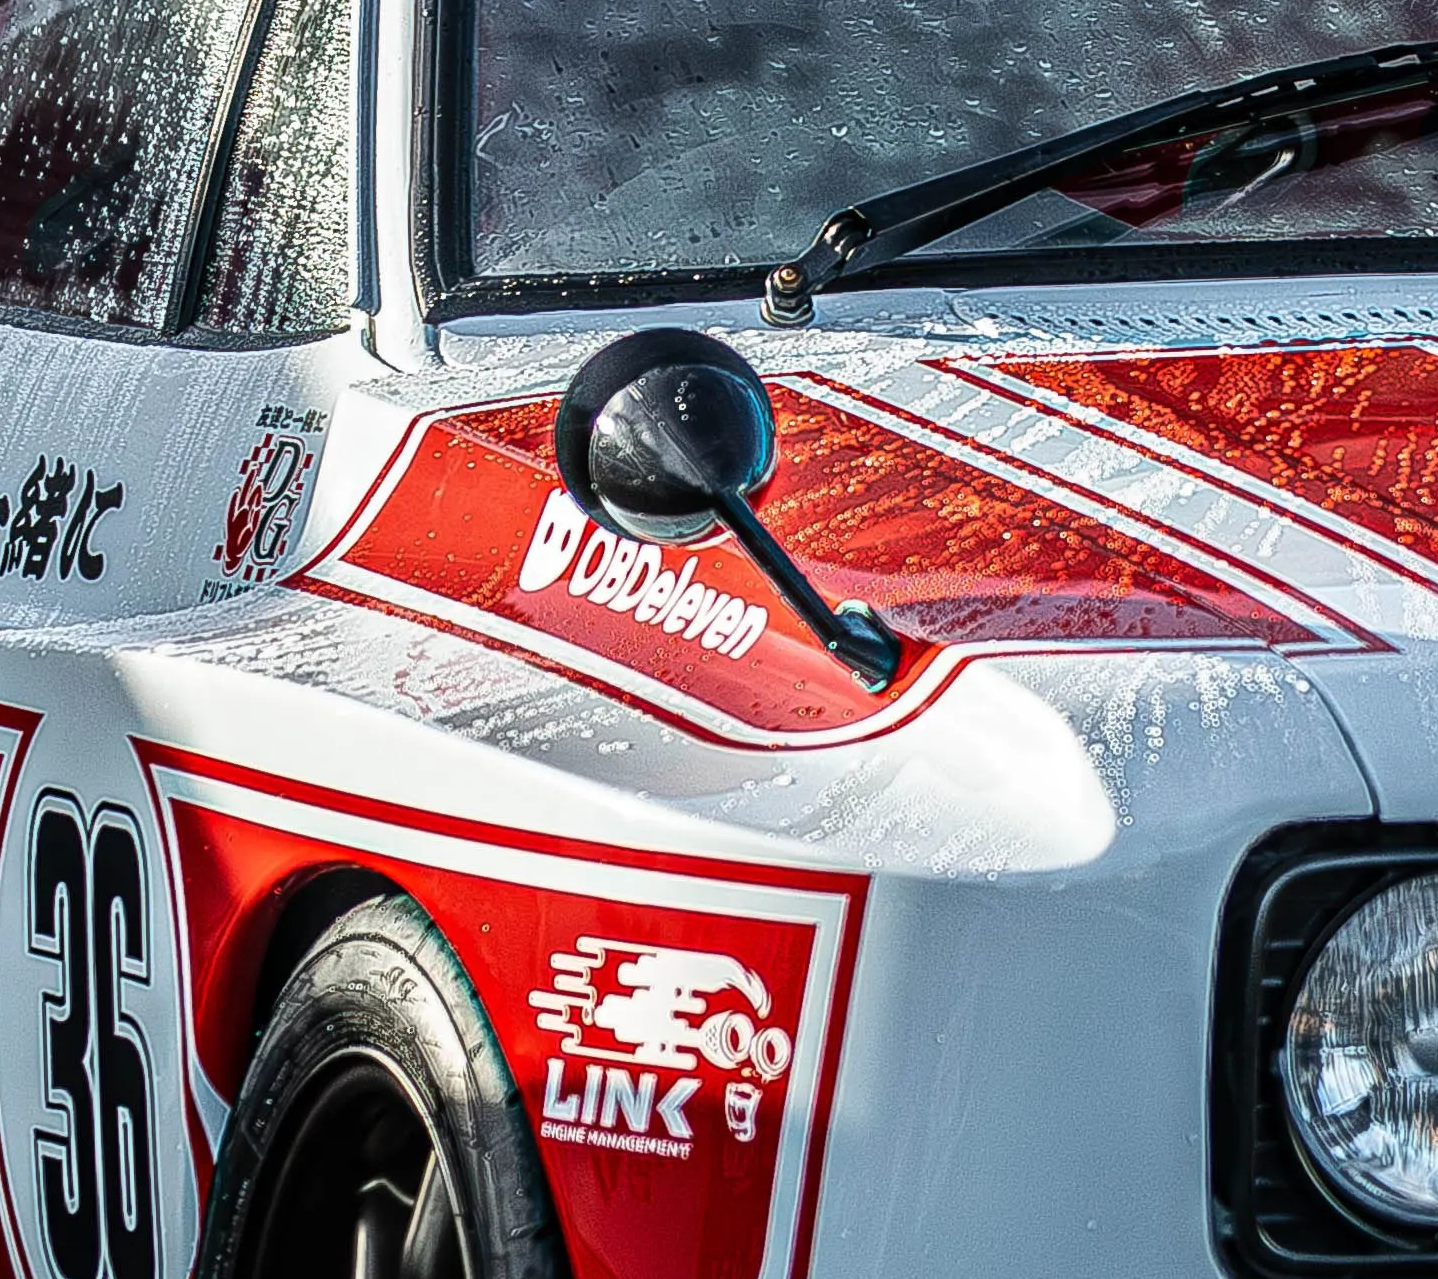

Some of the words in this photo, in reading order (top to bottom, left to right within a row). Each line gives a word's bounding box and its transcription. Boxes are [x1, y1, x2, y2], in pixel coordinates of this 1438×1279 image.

[568, 526, 768, 660] OBDeleven
[541, 1121, 586, 1144] ENGINE
[586, 1126, 694, 1160] MANAGEMENT
[542, 1057, 704, 1141] LINK
